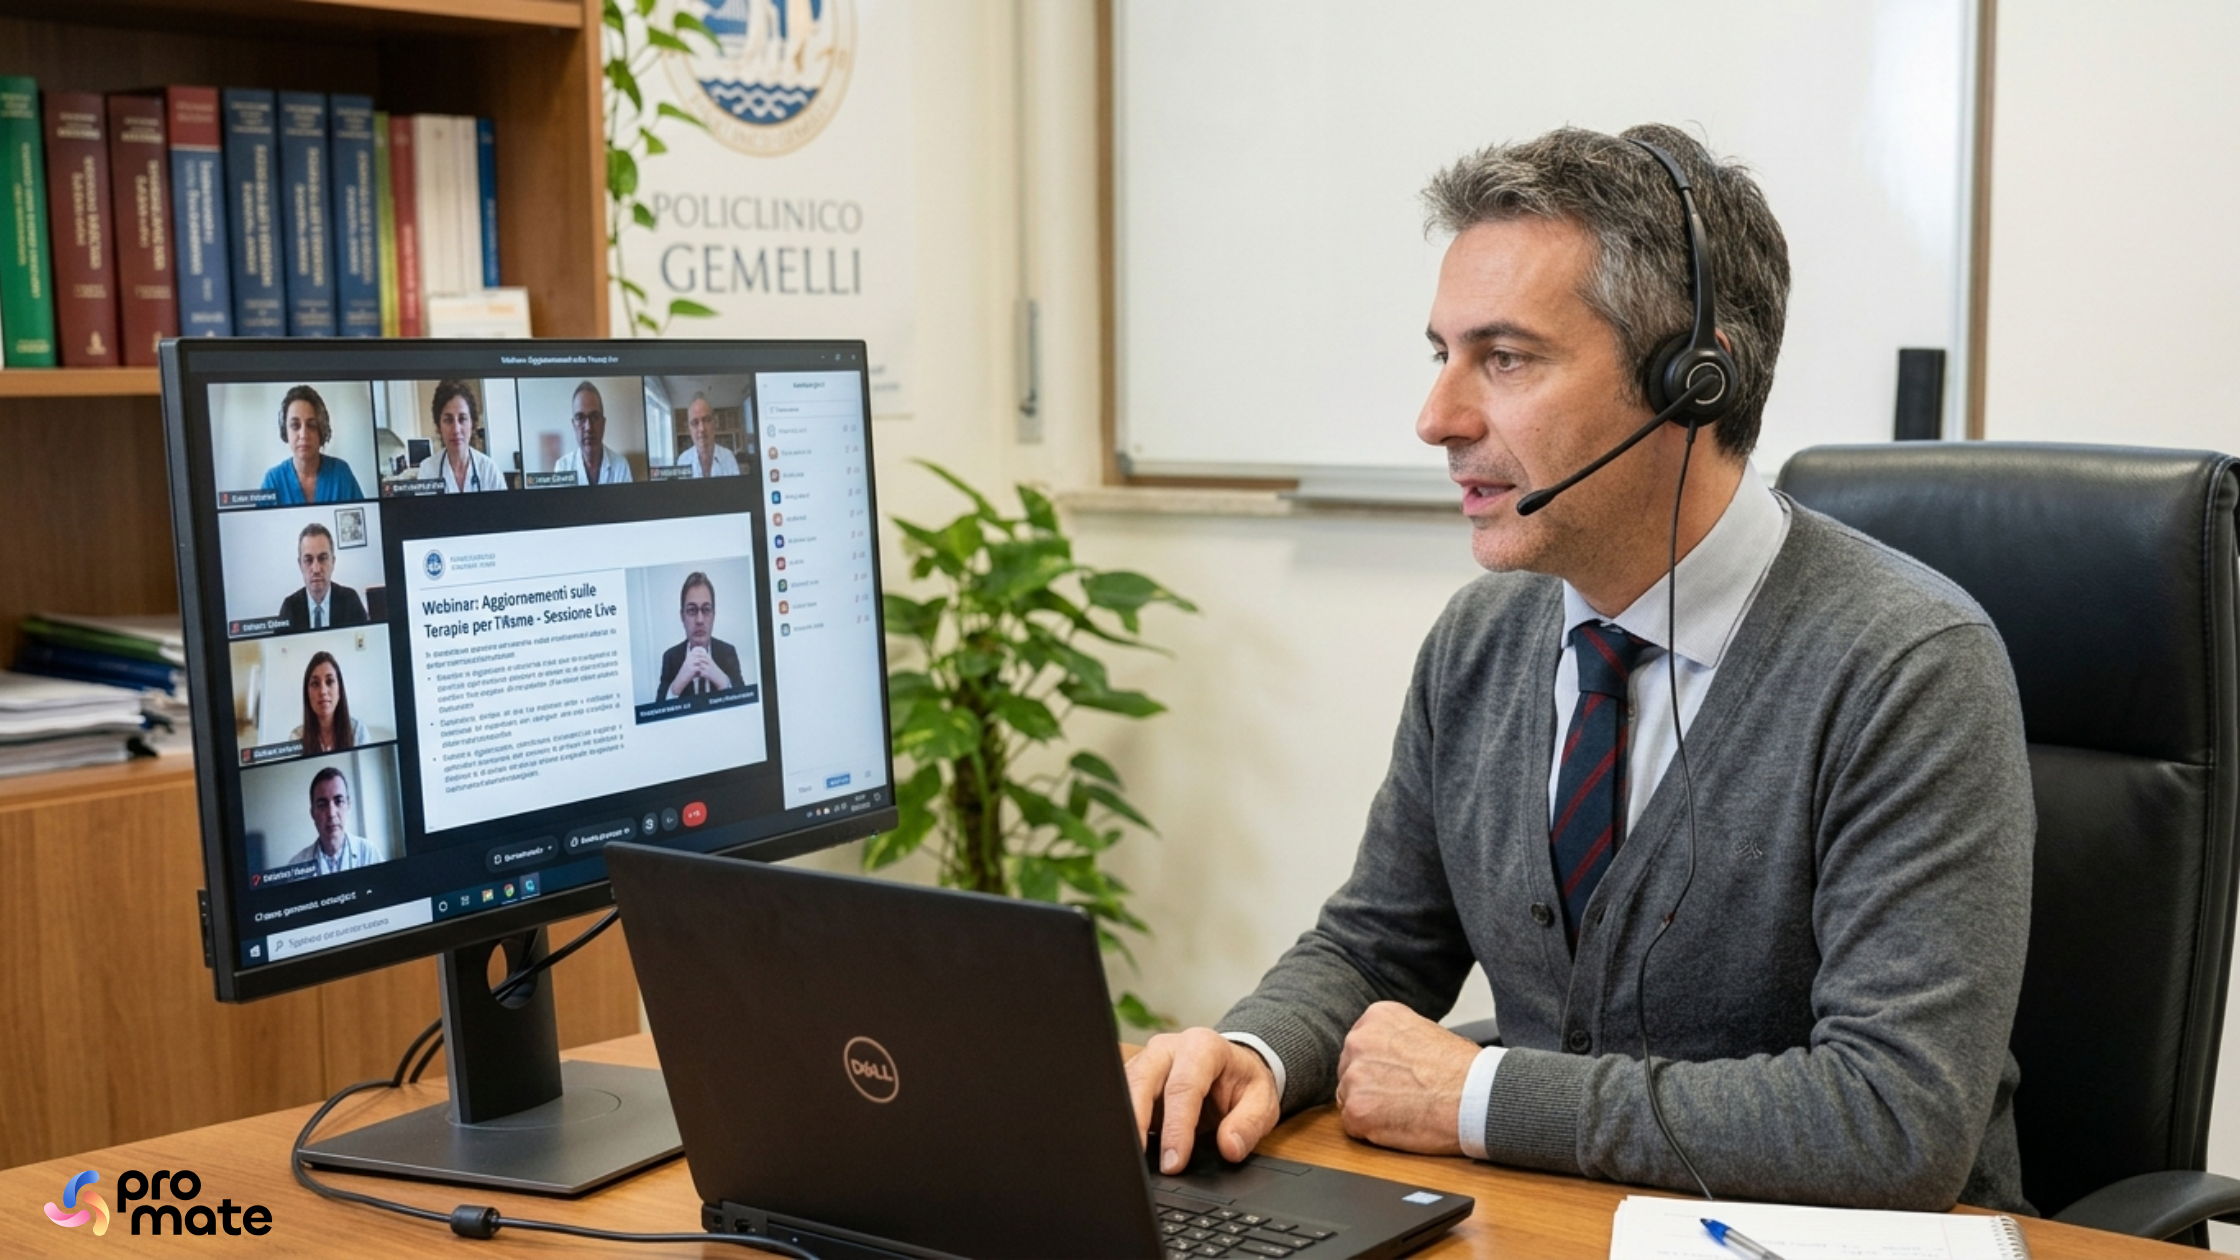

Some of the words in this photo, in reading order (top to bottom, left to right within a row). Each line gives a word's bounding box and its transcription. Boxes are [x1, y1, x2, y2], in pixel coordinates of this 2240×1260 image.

[652, 192, 864, 235] POLICLINICO
[660, 242, 861, 295] GEMELLI
[422, 597, 480, 616] Webinar:
[424, 619, 470, 639] Terapie
[472, 619, 493, 636] per
[543, 606, 592, 624] Sessione
[594, 602, 617, 618] Live
[850, 1058, 893, 1081] DELL
